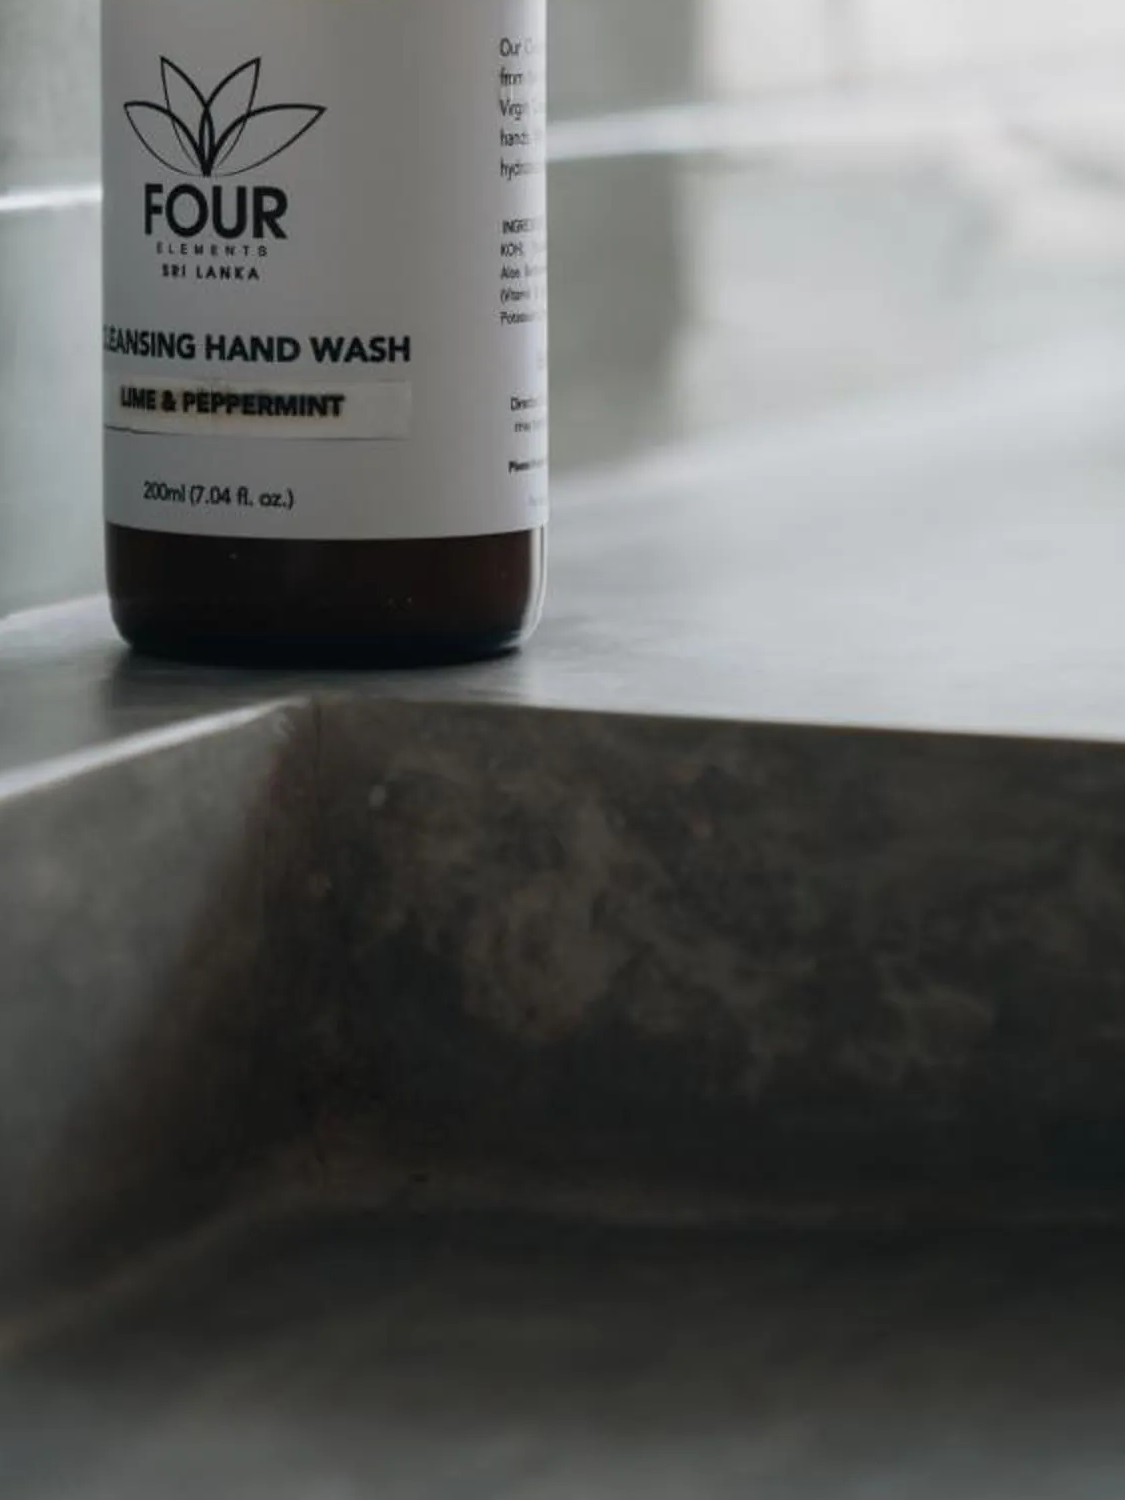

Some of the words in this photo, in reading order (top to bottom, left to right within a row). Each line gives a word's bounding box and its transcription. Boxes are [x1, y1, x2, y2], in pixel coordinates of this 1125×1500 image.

[144, 183, 289, 240] FOUR
[156, 241, 268, 258] ELEMENTS
[161, 263, 187, 278] SRI
[195, 265, 261, 280] LANKA
[205, 334, 302, 363] HAND
[310, 335, 412, 364] WASH
[120, 385, 157, 411] LIME
[161, 390, 177, 413] &
[182, 390, 346, 418] PEPPERMINT
[143, 480, 186, 502] 200ml
[190, 484, 232, 506] (7.04
[236, 486, 254, 506] fl.
[258, 488, 295, 510] oz.)
